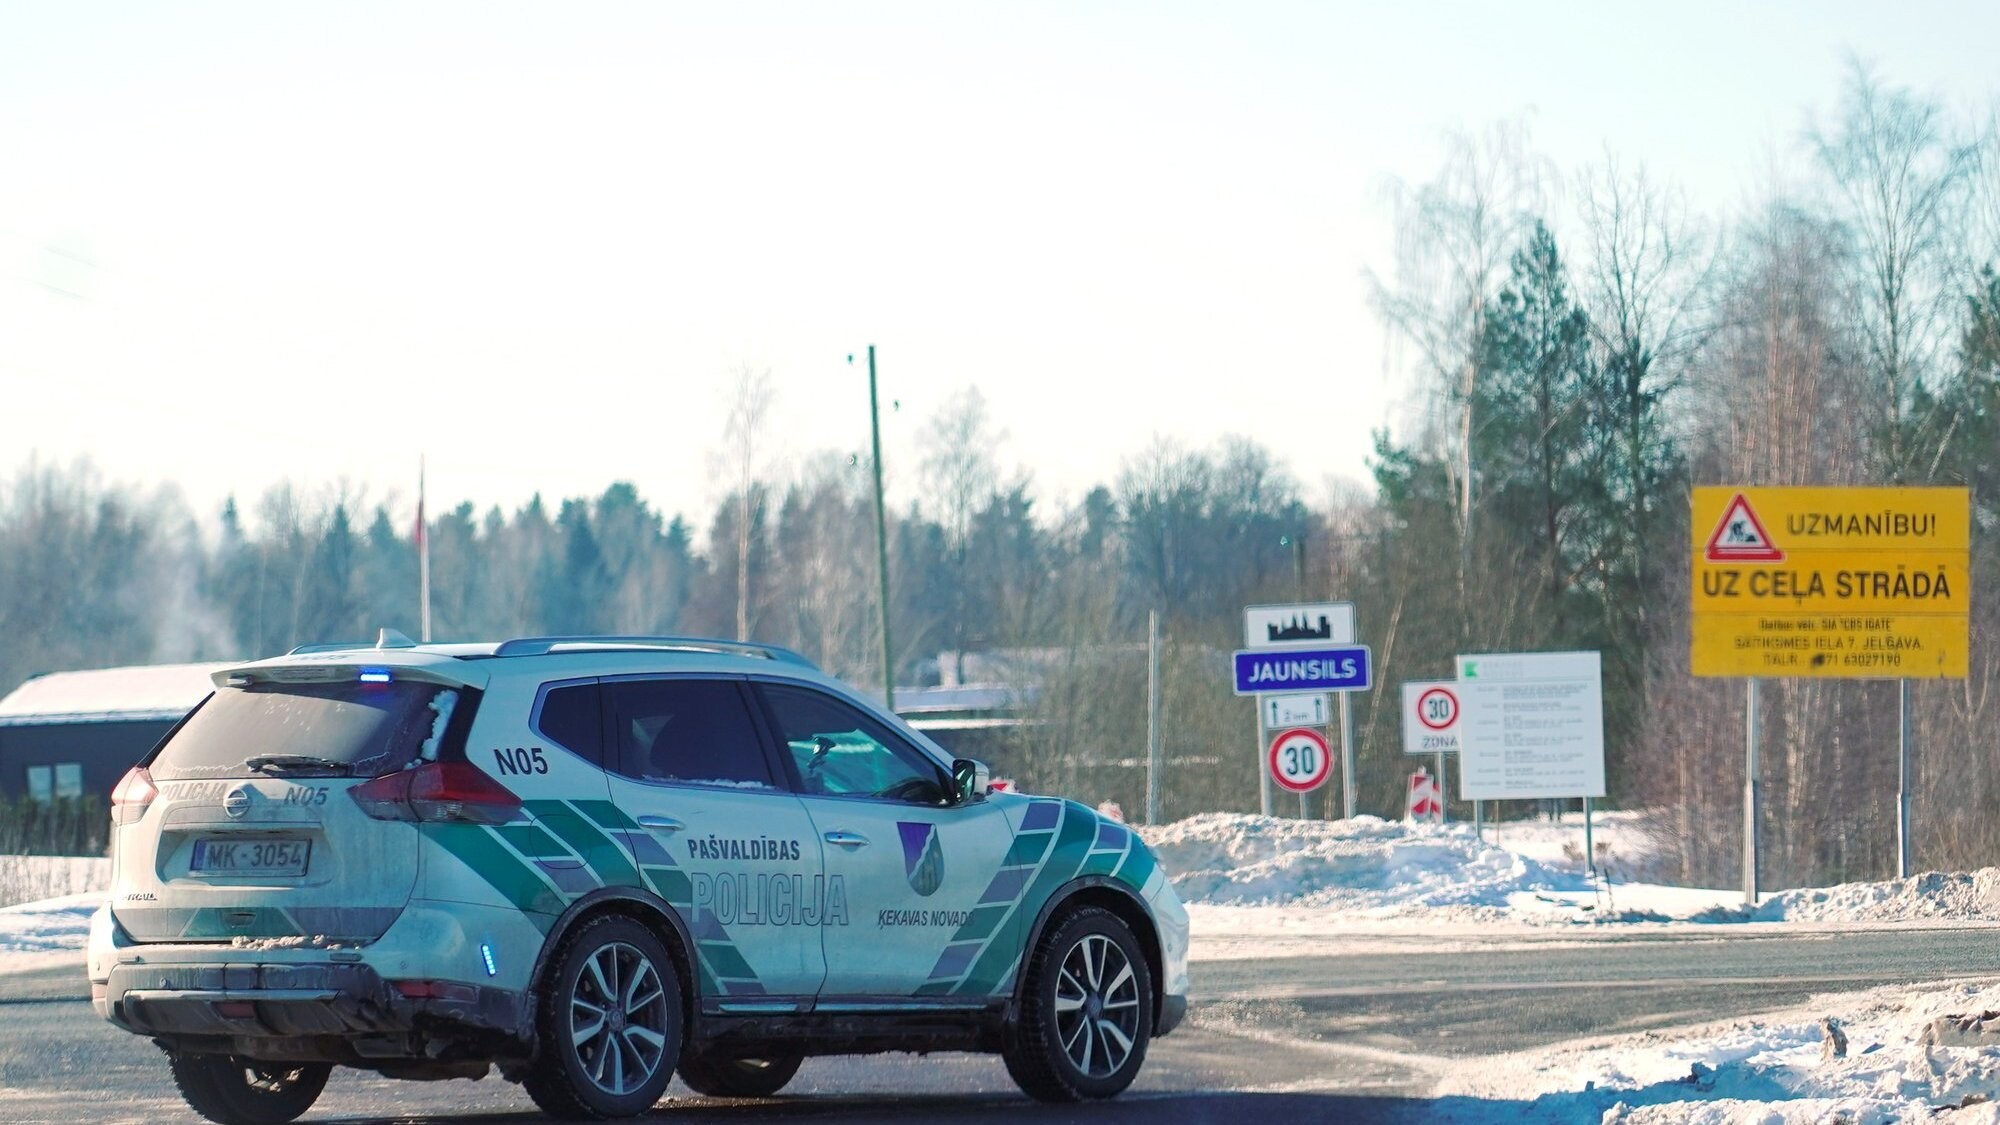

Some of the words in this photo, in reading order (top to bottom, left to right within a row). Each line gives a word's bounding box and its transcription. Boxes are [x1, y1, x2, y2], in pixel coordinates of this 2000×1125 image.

[1787, 510, 1936, 537] UZMANĪBU!
[1703, 569, 1739, 597] UZ
[1749, 570, 1826, 606] CEĻA
[1836, 565, 1950, 599] STRĀDĀ
[1822, 618, 1837, 630] SIA
[1815, 636, 1843, 650] IELA
[1249, 658, 1358, 683] JAUNSILS
[1428, 698, 1450, 720] 30
[1423, 735, 1459, 749] ZONA
[1285, 746, 1315, 776] 30
[162, 782, 229, 801] POLICIJA
[687, 834, 801, 860] PAŠVALDĪBAS
[691, 872, 849, 926] POLICIJA
[878, 909, 929, 931] ĶEKAVAS
[930, 910, 975, 927] NOVADS
